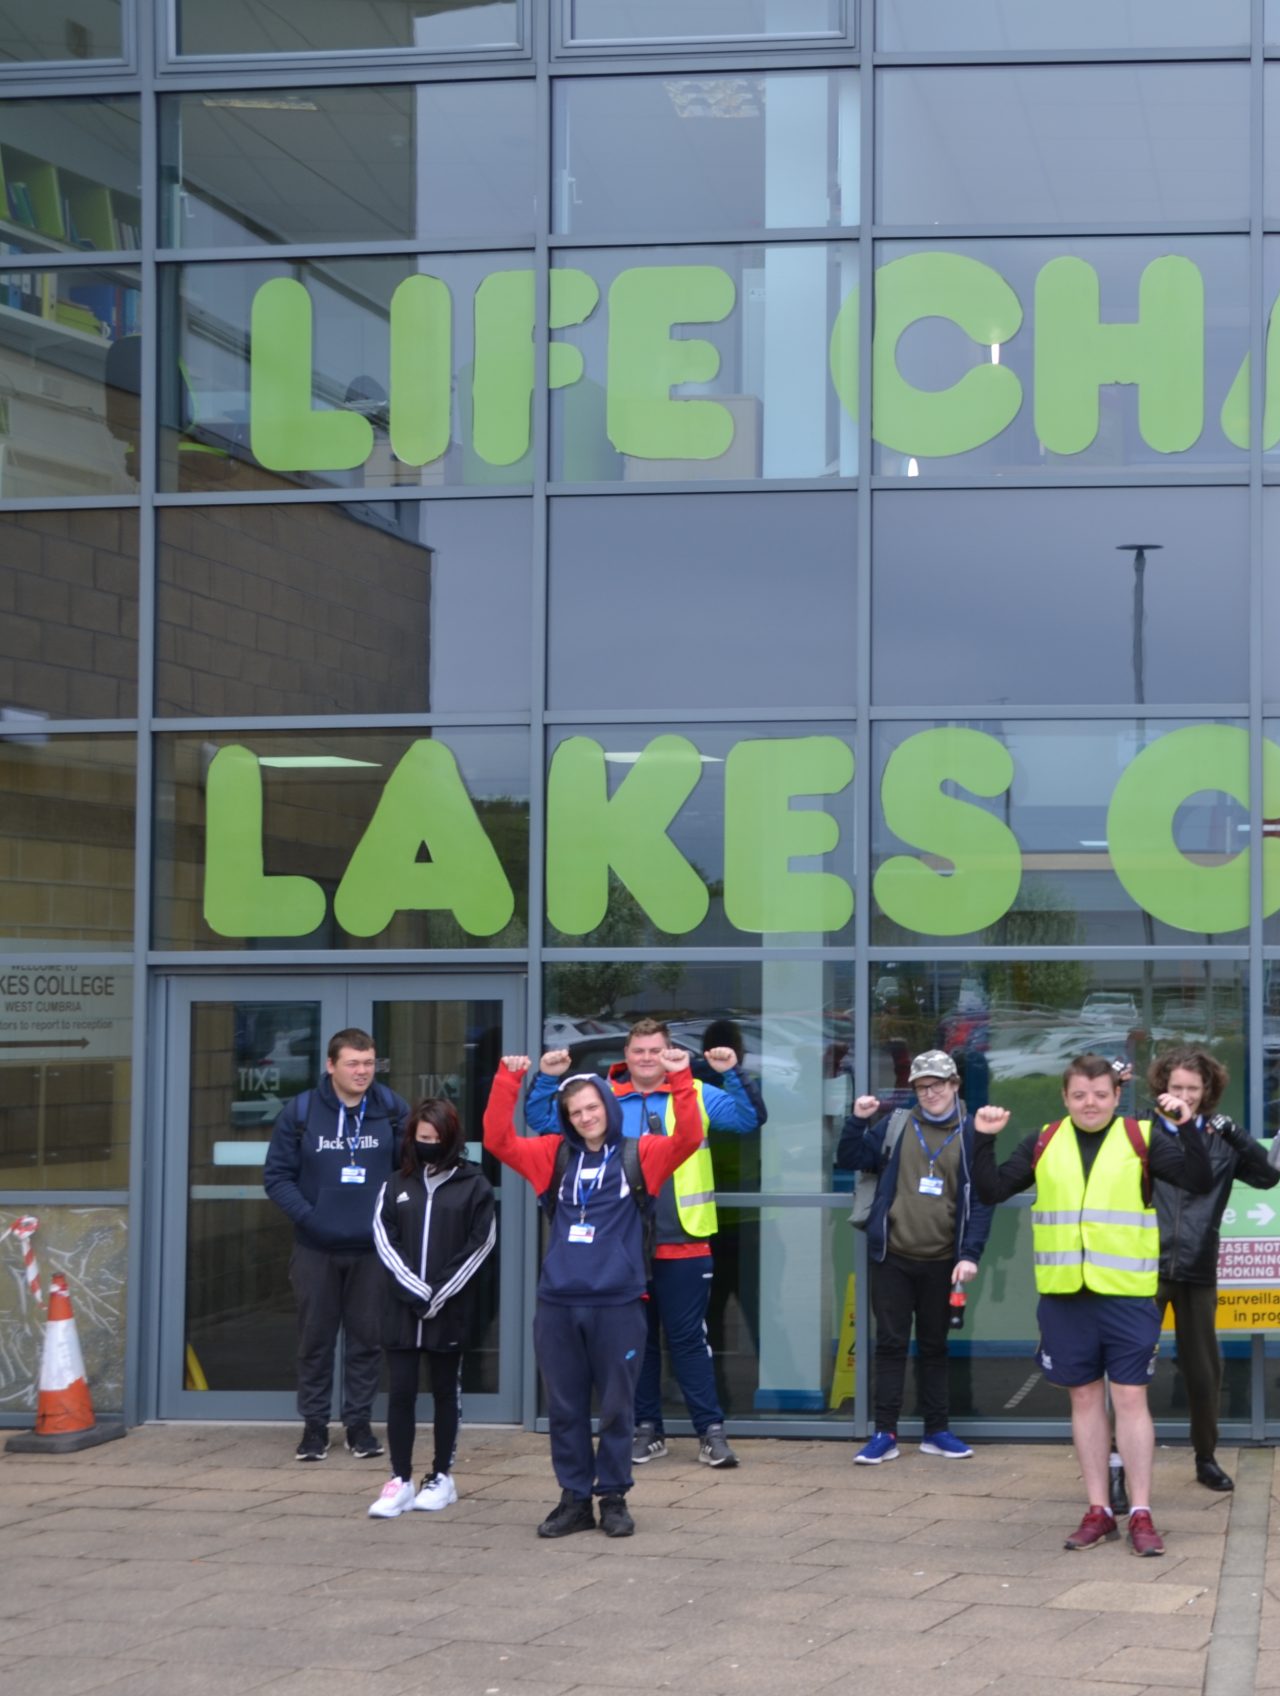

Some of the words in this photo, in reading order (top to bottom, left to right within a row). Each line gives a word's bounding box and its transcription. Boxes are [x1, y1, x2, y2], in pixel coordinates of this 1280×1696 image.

[250, 264, 737, 473] LIFE
[203, 731, 1021, 938] LAKES
[34, 975, 115, 996] COLLEGE
[5, 1001, 33, 1013] WEST
[35, 1001, 82, 1013] CUMBRIA
[316, 1136, 344, 1152] Jack
[1234, 1310, 1247, 1322] in
